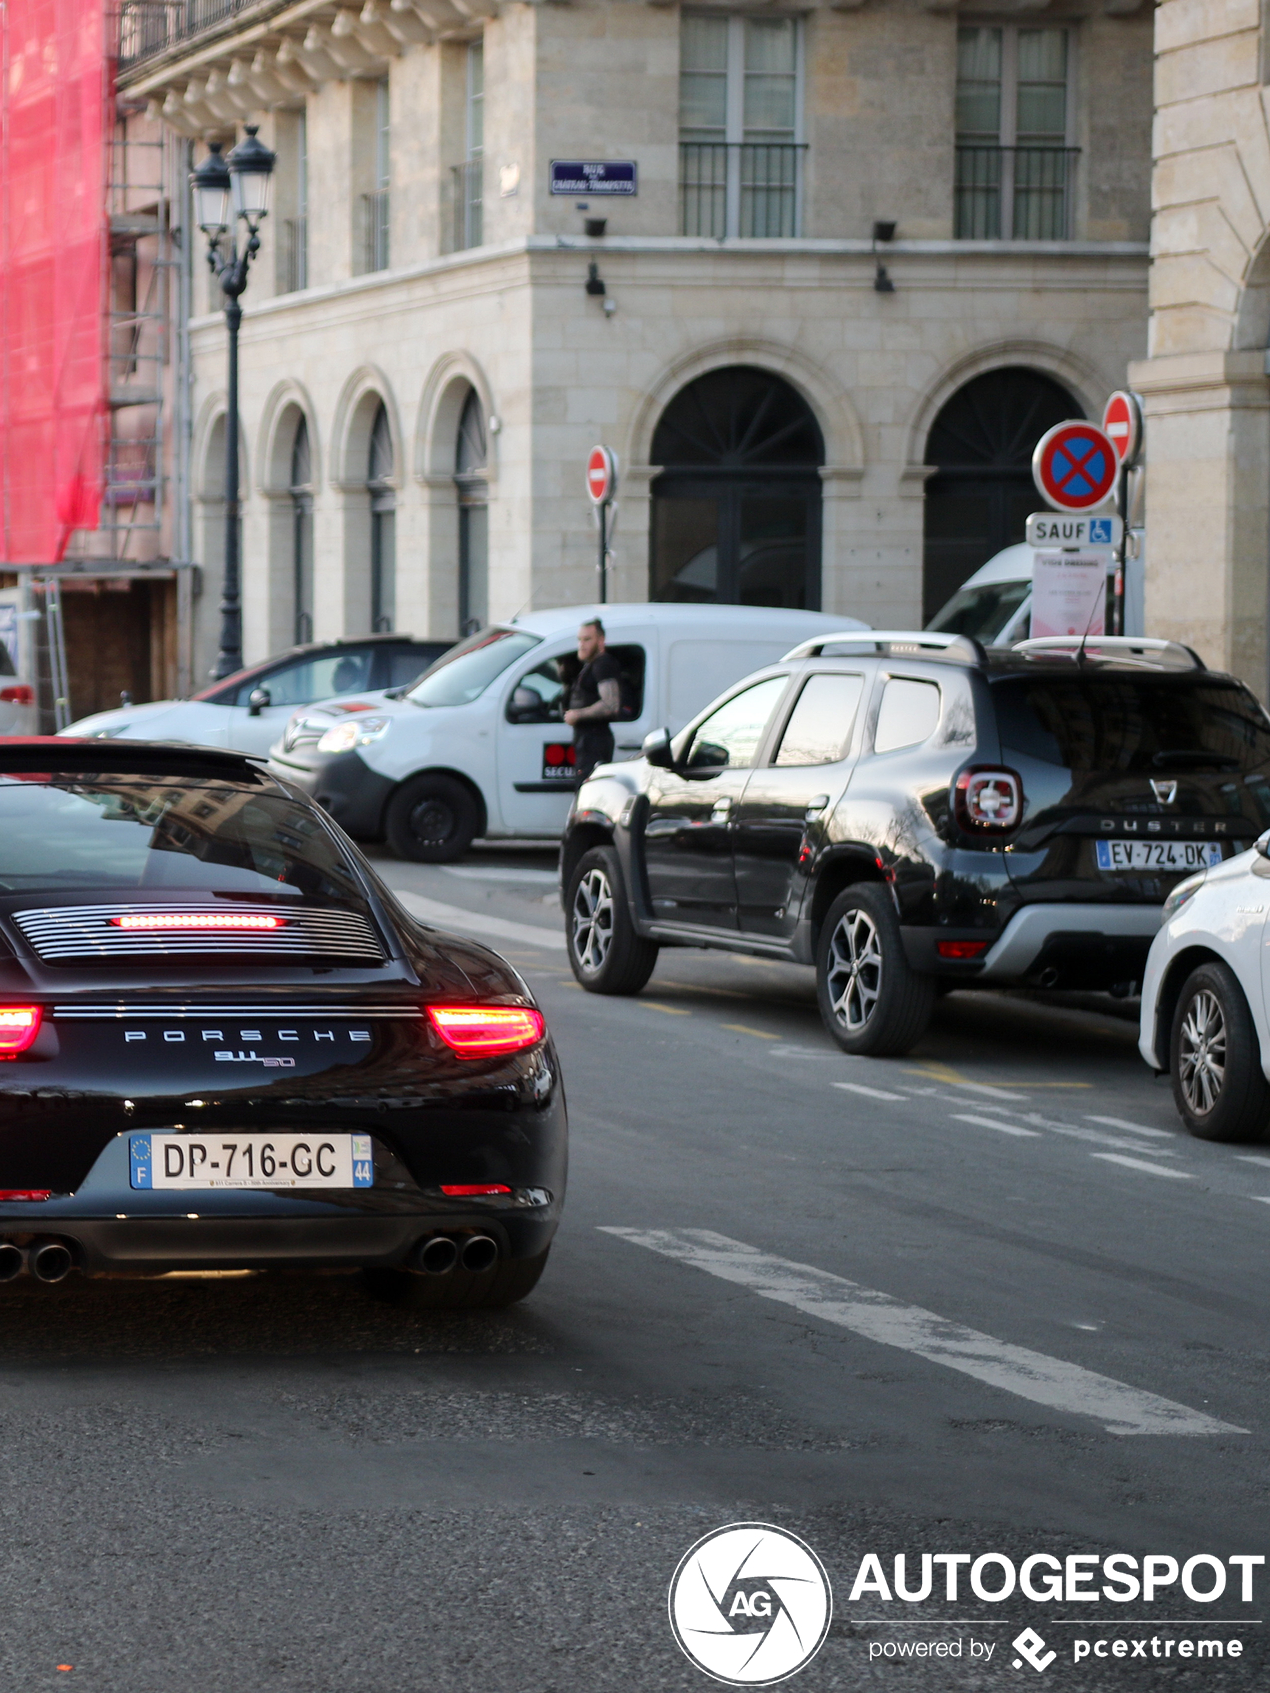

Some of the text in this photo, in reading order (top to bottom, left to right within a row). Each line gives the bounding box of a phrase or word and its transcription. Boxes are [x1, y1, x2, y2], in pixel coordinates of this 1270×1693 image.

[583, 164, 605, 175] RUE
[1036, 522, 1085, 539] SAUF
[1100, 820, 1228, 833] DUSTER
[1111, 843, 1207, 865] EV-724-DK
[124, 1030, 371, 1043] PORSCHE
[213, 1050, 296, 1067] 911 50
[136, 1143, 371, 1184] F DP-716-GC 44
